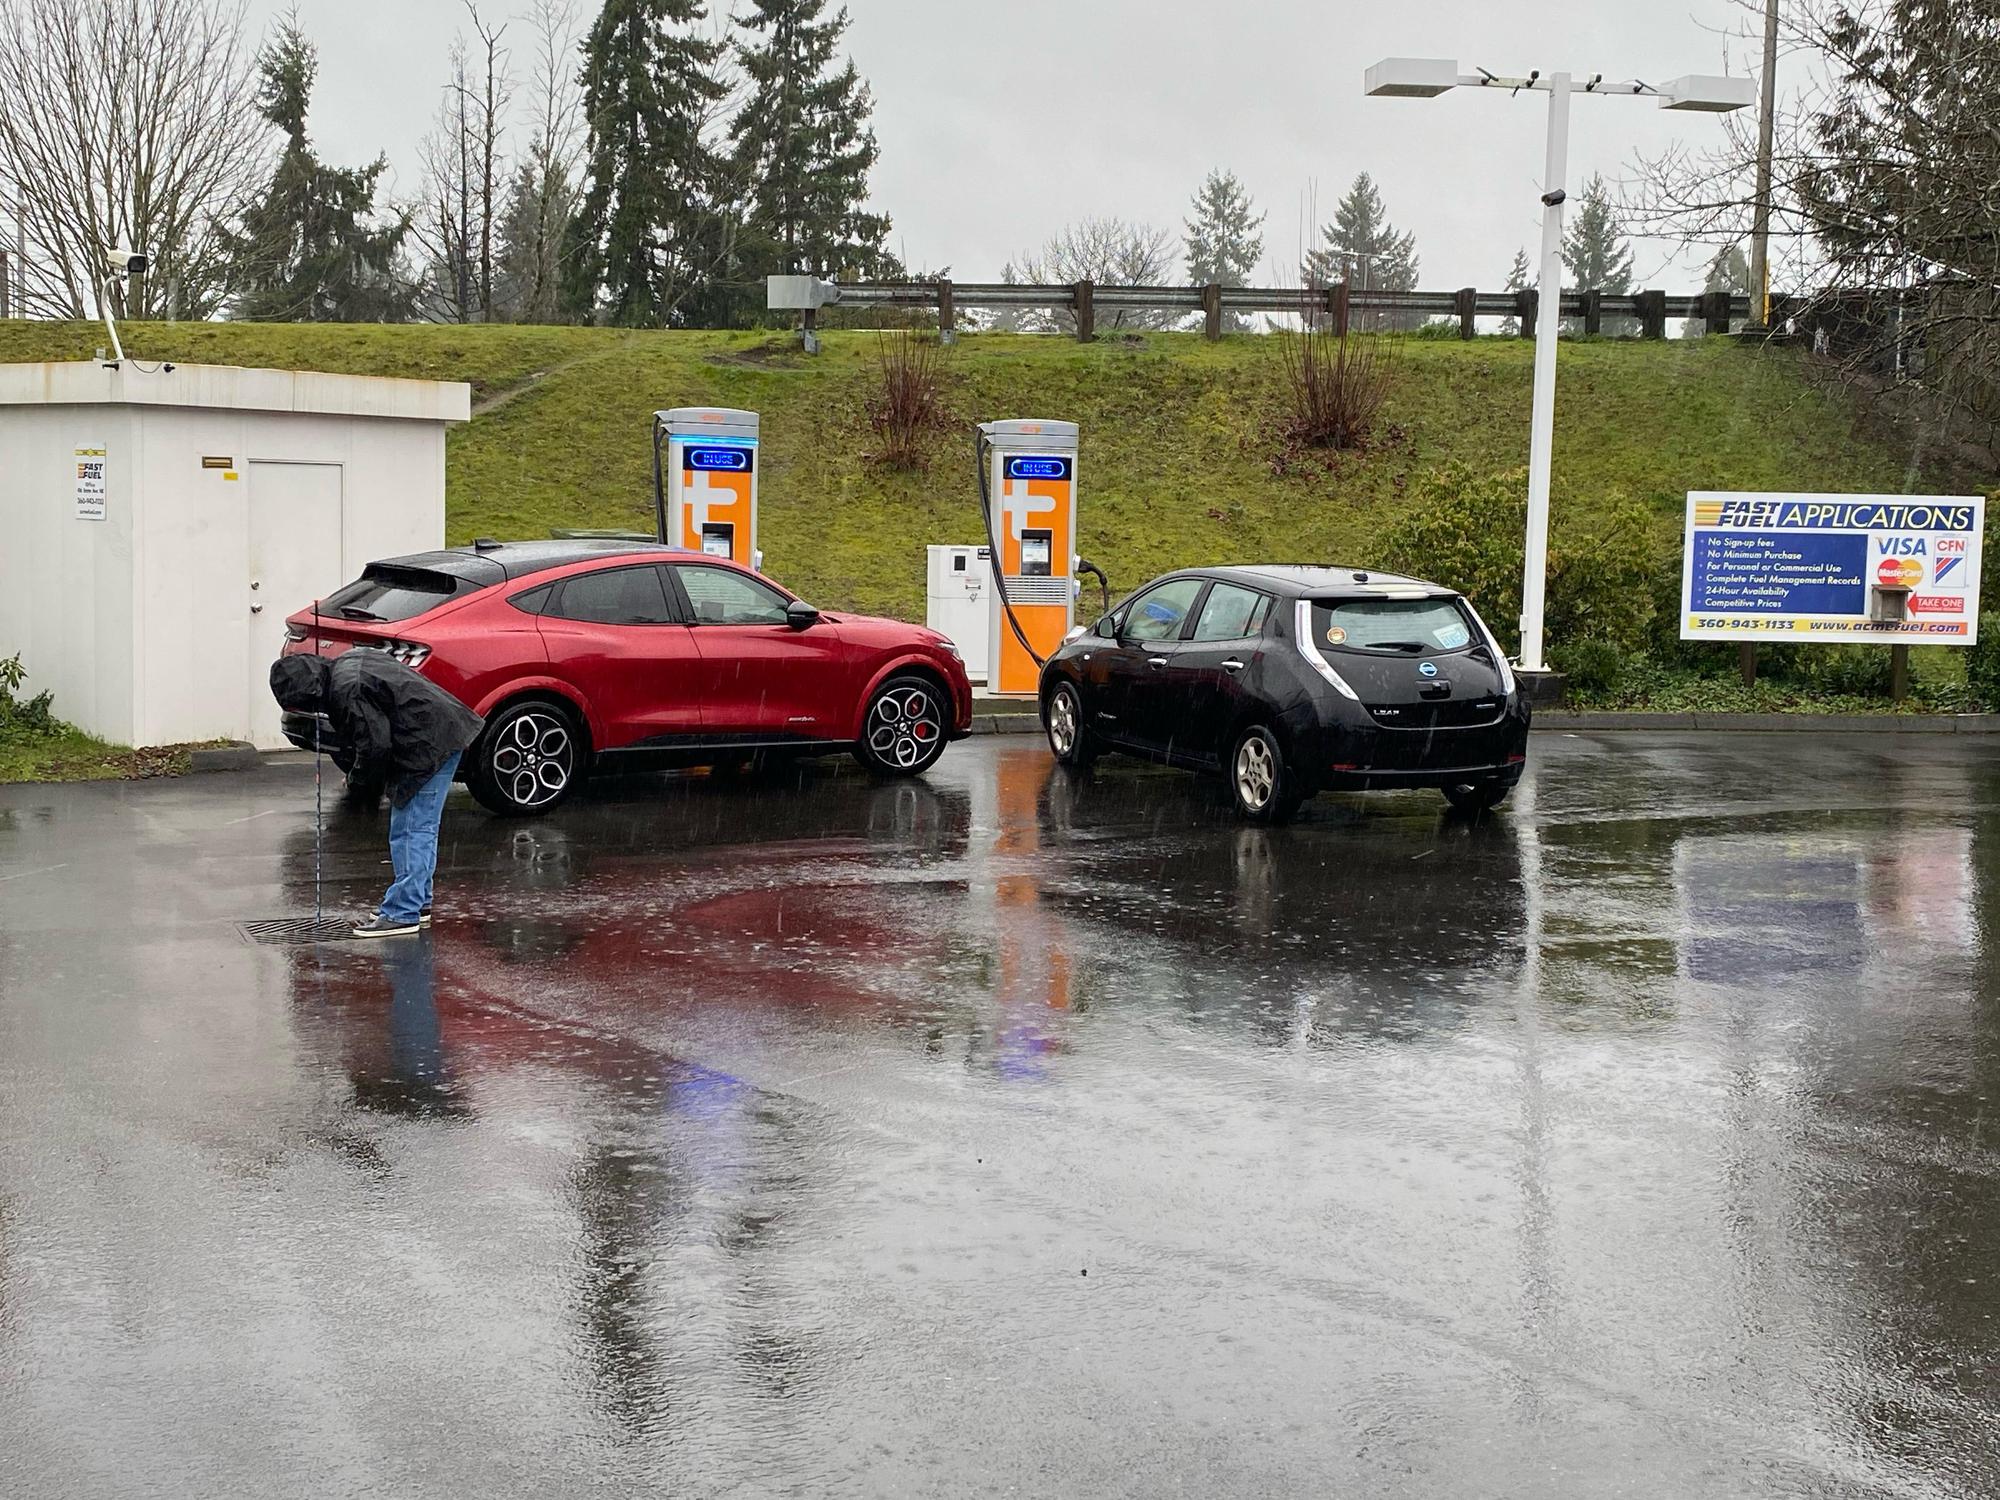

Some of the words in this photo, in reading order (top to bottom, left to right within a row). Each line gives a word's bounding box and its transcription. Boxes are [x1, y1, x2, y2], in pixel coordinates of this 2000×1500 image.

[84, 463, 103, 471] FAST
[83, 471, 102, 479] FUEL
[1721, 501, 1781, 514] FAST
[1717, 514, 1775, 528] FUEL
[1782, 504, 1970, 529] APPLICATIONS
[1707, 537, 1722, 546] No
[1724, 537, 1755, 548] Sign-up
[1757, 537, 1775, 547] fees
[1875, 536, 1927, 556] VISA
[1936, 540, 1965, 552] CFN
[1707, 549, 1721, 558] No
[1723, 550, 1762, 559] Minimum
[1764, 550, 1802, 560] Purchase
[1706, 561, 1721, 570] For
[1723, 562, 1760, 571] Personal
[1773, 562, 1824, 572] Commercial
[1825, 563, 1842, 573] Use
[1879, 568, 1922, 578] MasterCard
[1706, 573, 1747, 584] Complete
[1749, 574, 1767, 583] Fuel
[1768, 575, 1825, 586] Management
[1827, 575, 1861, 585] Records
[1705, 585, 1740, 595] 24-Hour
[1741, 587, 1790, 598] Availability
[1704, 598, 1755, 609] Competitive
[1757, 598, 1782, 608] Prices
[1918, 598, 1940, 607] TAKE
[1941, 598, 1963, 608] ONE
[1697, 618, 1795, 629] 360-943-1133
[1810, 620, 1960, 633] www.acmefuel.com
